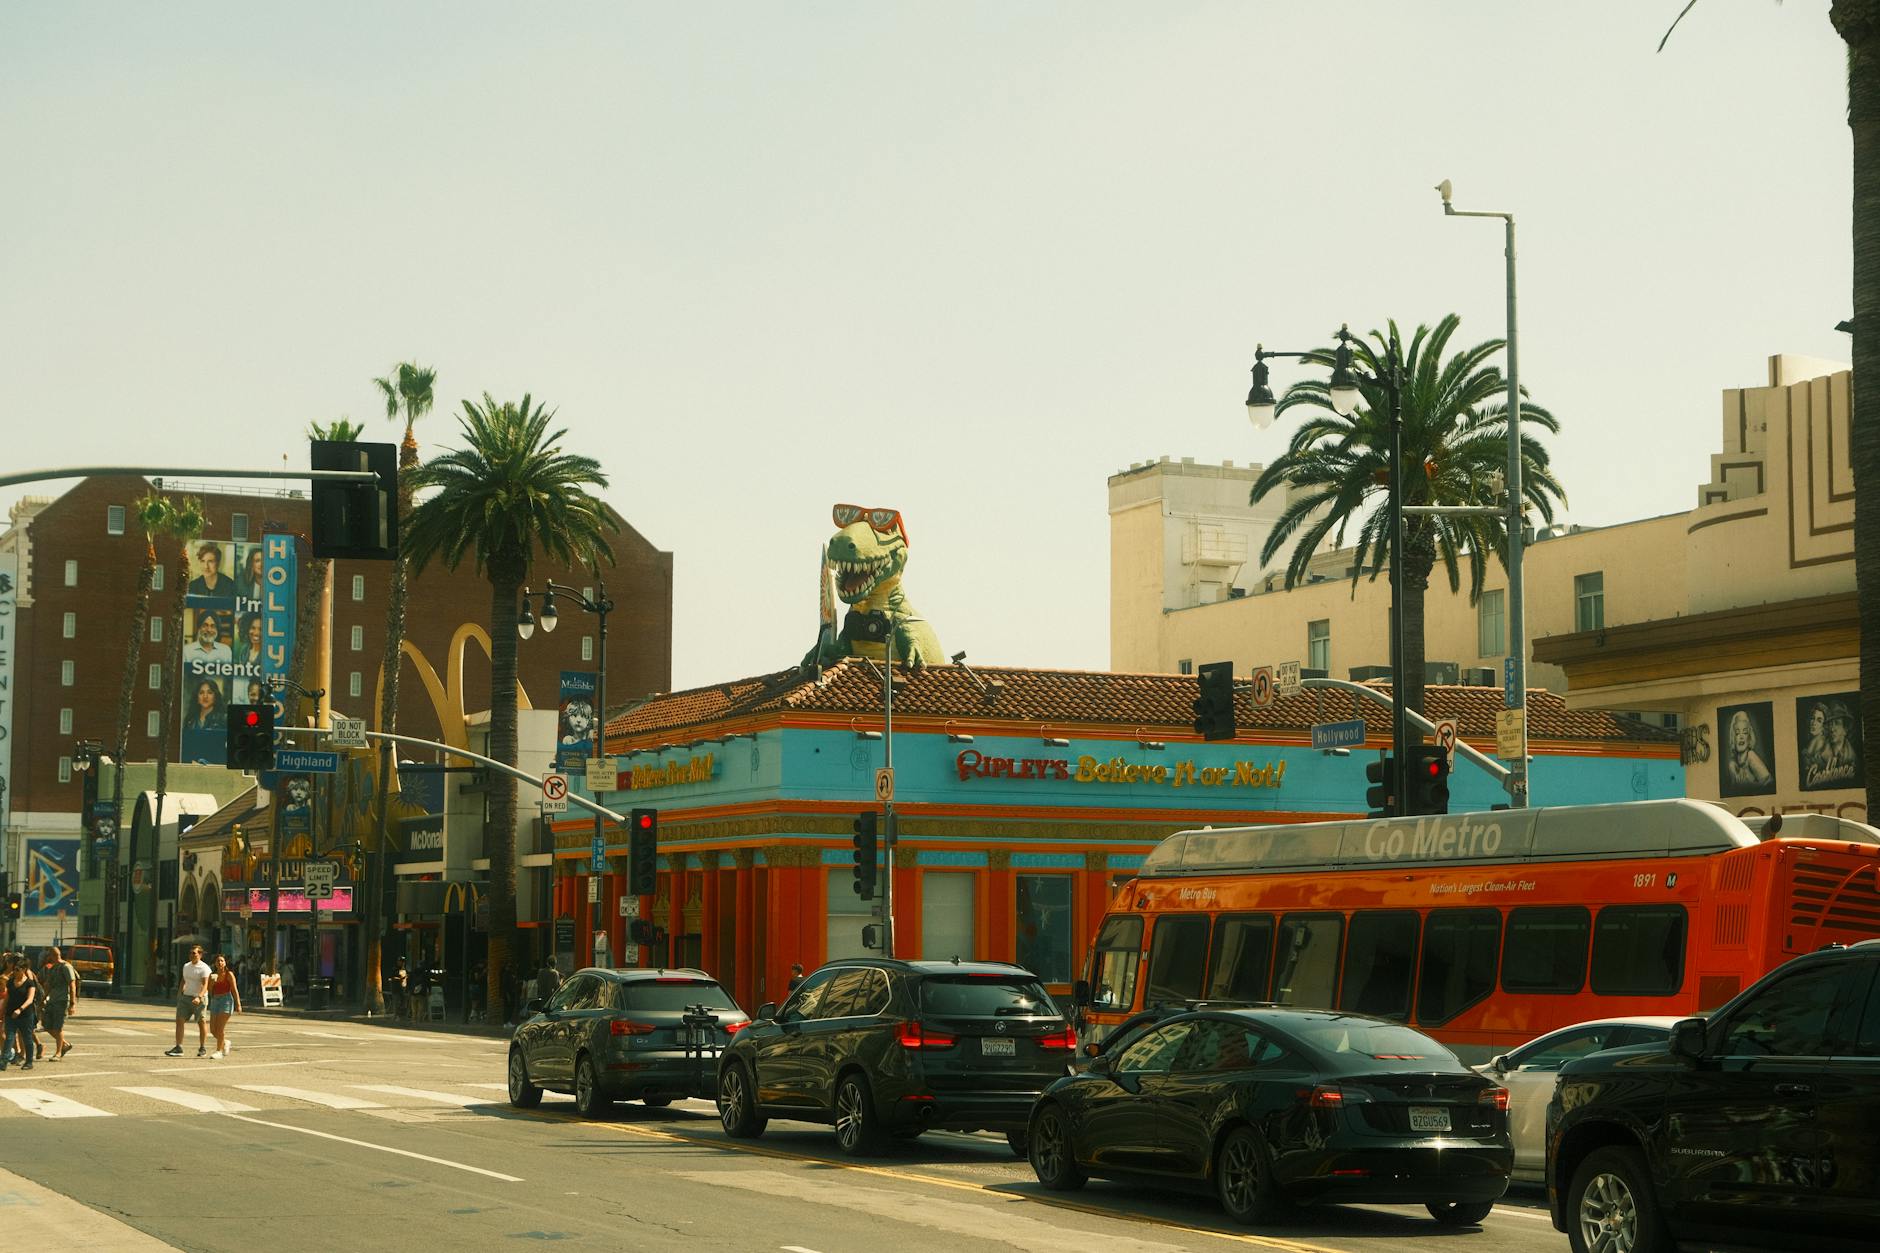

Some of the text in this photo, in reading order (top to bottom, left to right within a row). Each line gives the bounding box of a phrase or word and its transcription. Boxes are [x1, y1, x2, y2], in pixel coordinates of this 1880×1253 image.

[337, 722, 362, 730] DO NOT
[338, 731, 360, 739] BLOCK
[1317, 727, 1359, 744] Hollywood
[282, 755, 332, 769] Highland
[956, 749, 1287, 789] RIPLEY'S Believe It or Not!
[554, 802, 565, 810] RED
[1365, 816, 1502, 861] Go Metro
[1430, 880, 1536, 895] Nation's Largest Clean-Air Fleet
[1633, 873, 1656, 888] 1891
[306, 883, 331, 897] 25
[1179, 887, 1217, 900] Metro Bus
[1671, 1147, 1726, 1157] SUBURBAN
